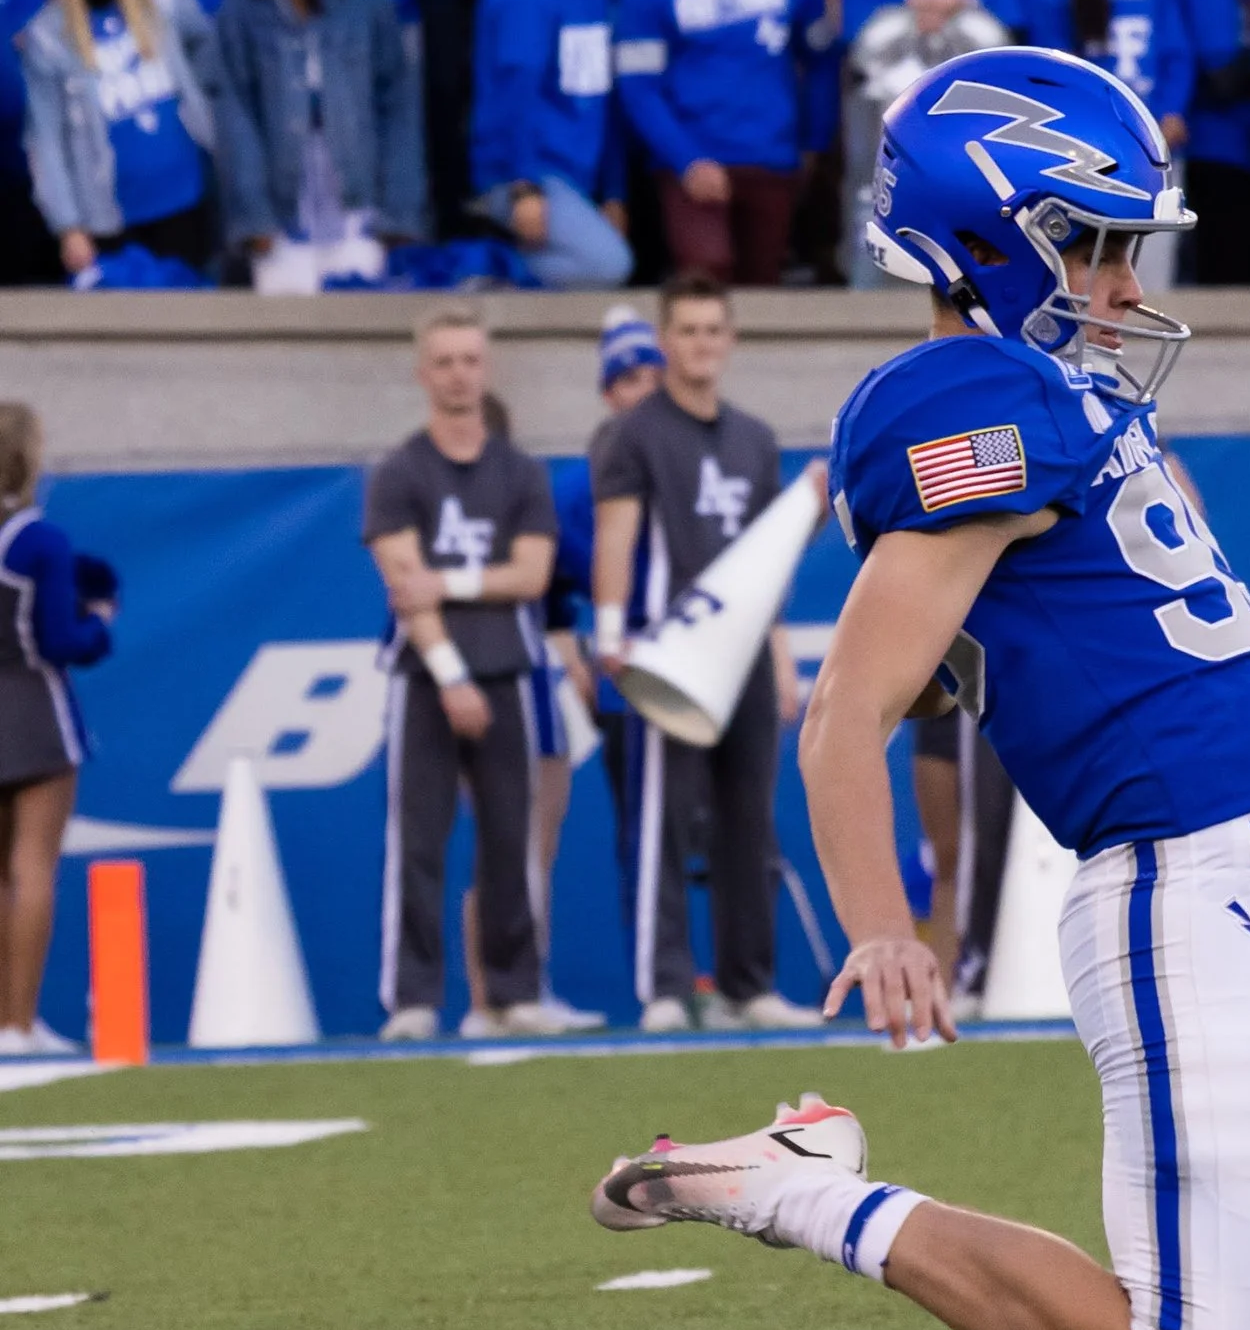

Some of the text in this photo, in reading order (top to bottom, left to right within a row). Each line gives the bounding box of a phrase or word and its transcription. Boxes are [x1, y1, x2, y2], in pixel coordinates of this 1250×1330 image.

[1090, 416, 1160, 488] AIR
[433, 496, 496, 571] AF
[695, 456, 750, 537] AF
